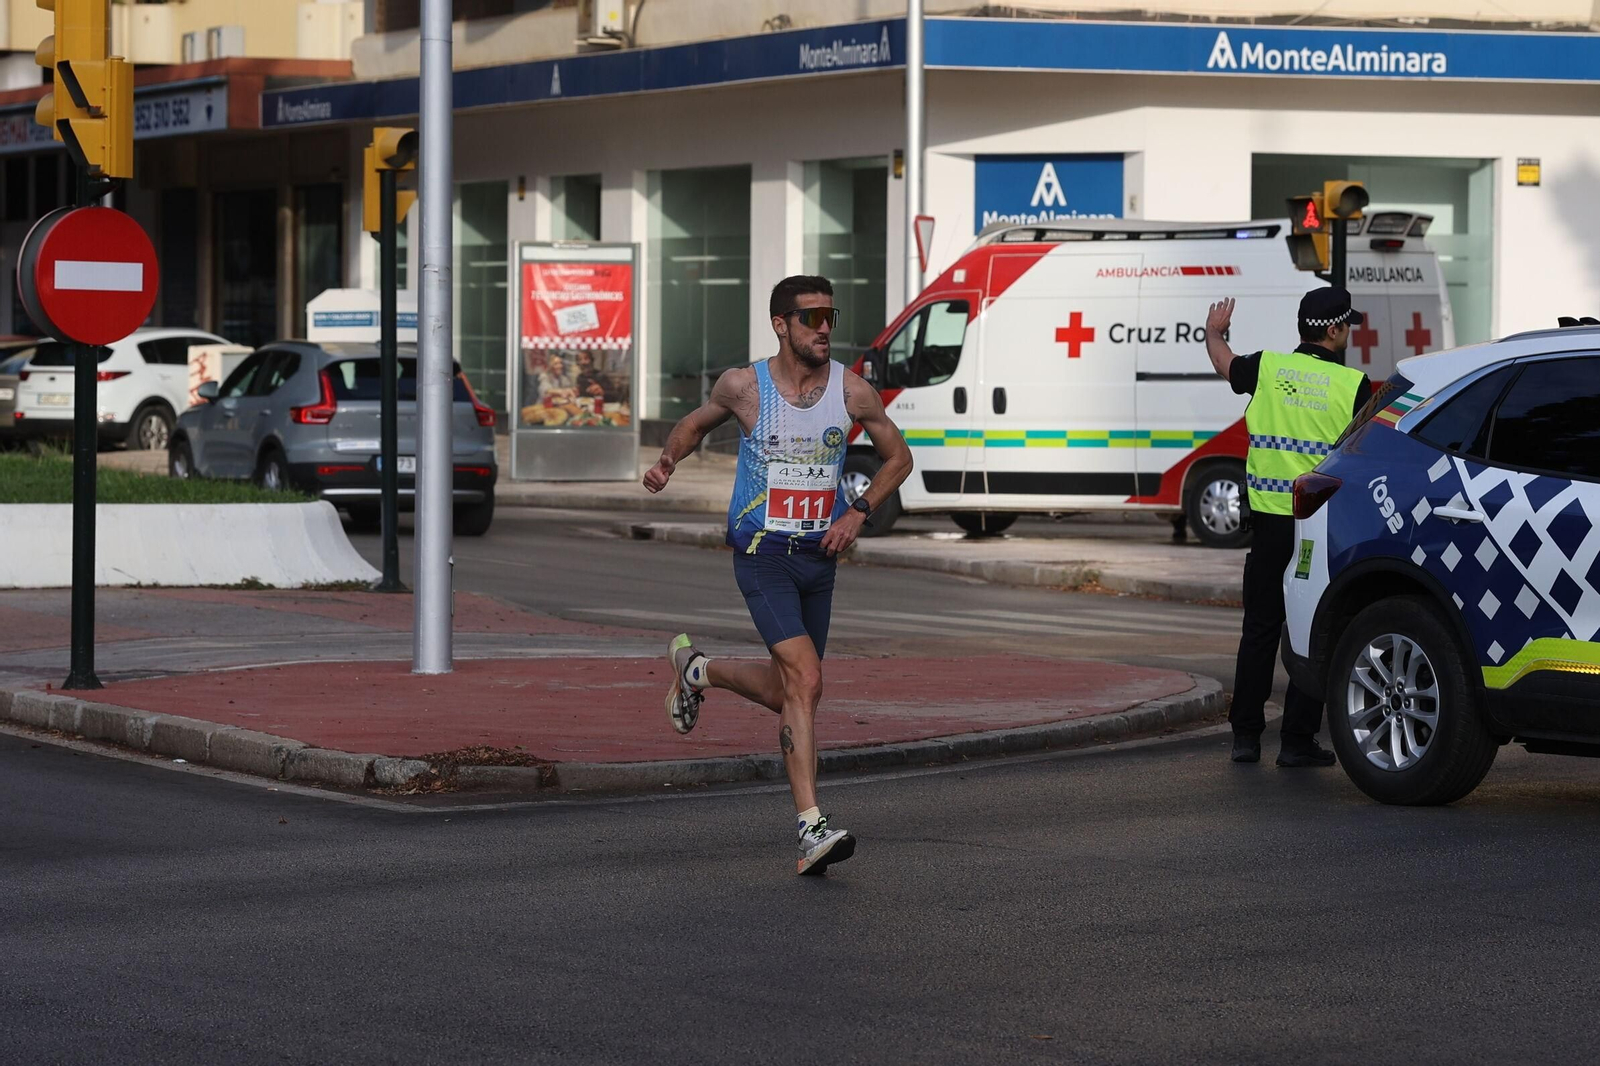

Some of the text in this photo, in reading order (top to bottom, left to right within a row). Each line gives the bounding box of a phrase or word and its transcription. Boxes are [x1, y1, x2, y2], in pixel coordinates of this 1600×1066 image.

[799, 38, 878, 69] MonteAlminara
[1241, 42, 1447, 73] MonteAlminara
[1097, 266, 1180, 278] AMBULANCIA
[1349, 266, 1424, 283] AMBULANCIA
[1109, 322, 1230, 344] Cruz Ro
[1276, 367, 1330, 387] POLICÍA
[1298, 386, 1328, 399] LOCAL
[779, 467, 803, 477] 45
[783, 495, 824, 519] 111
[1373, 483, 1404, 534] 092
